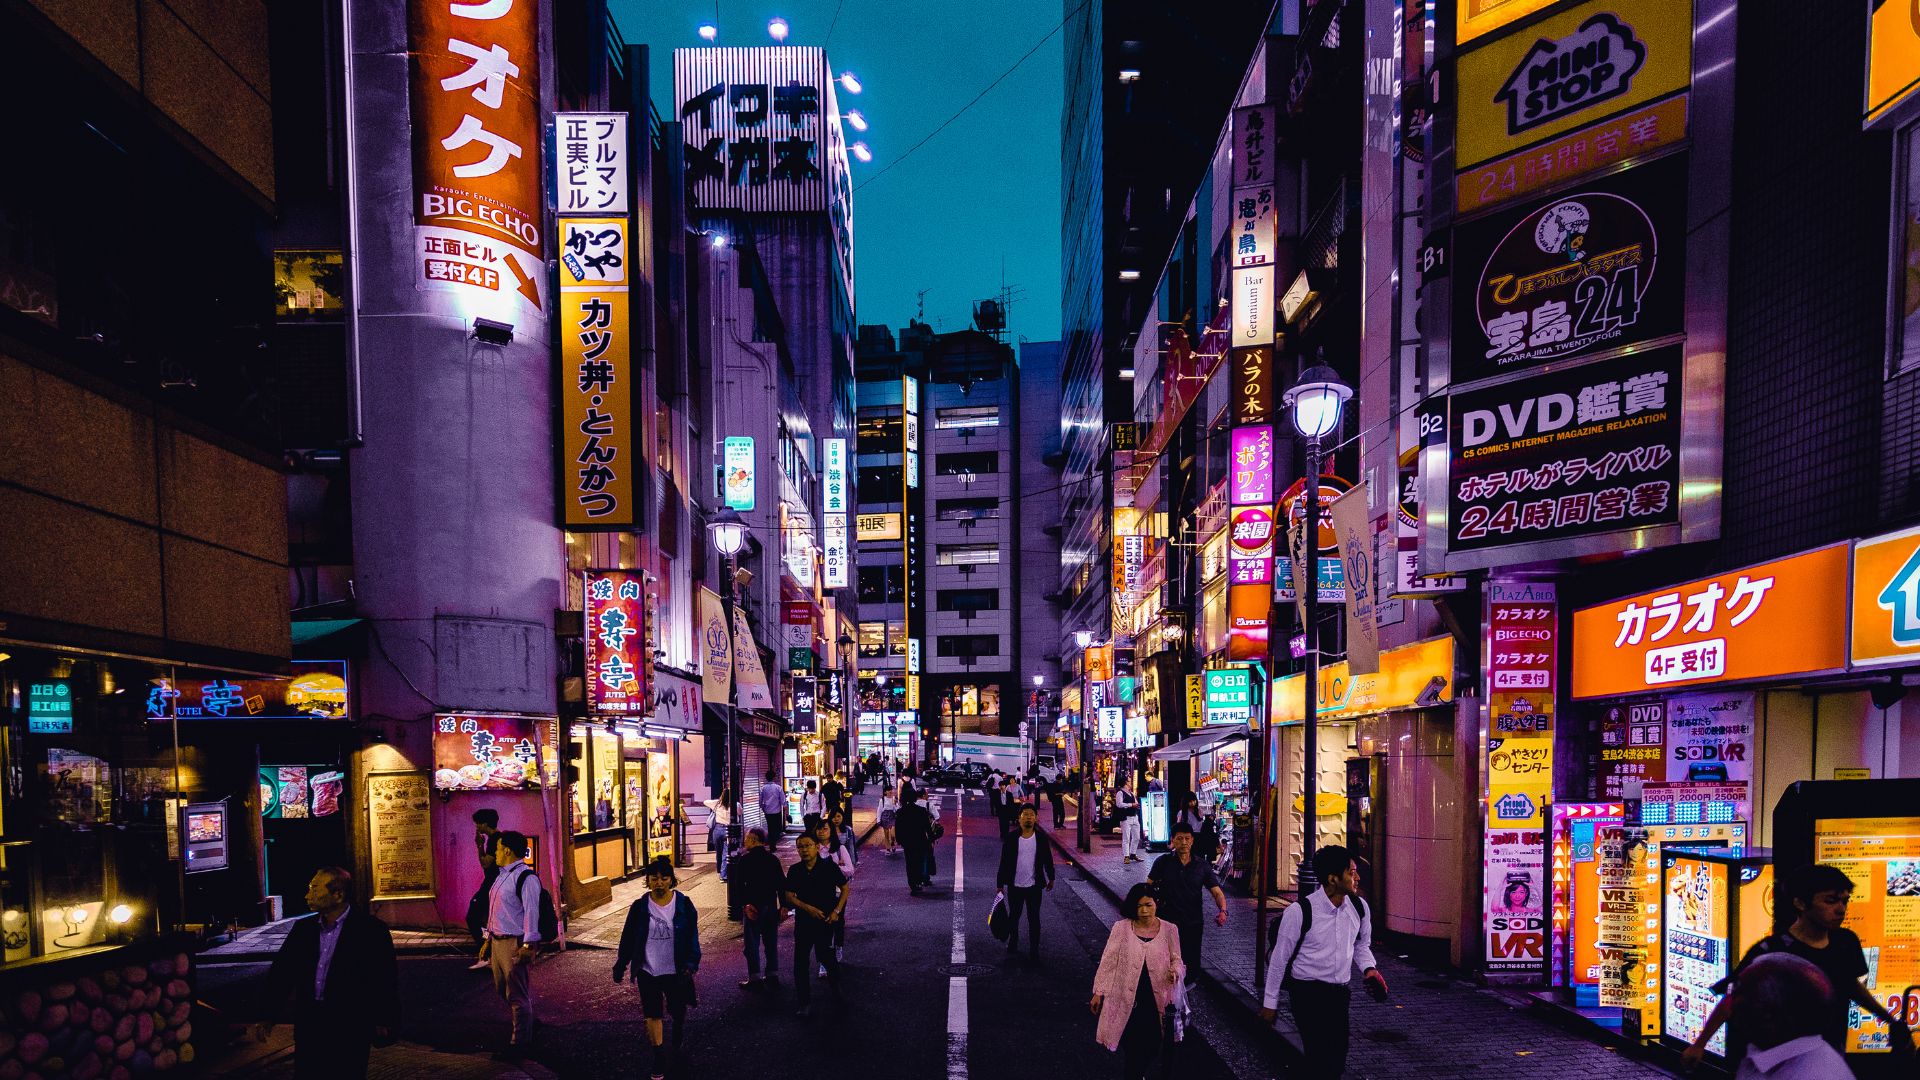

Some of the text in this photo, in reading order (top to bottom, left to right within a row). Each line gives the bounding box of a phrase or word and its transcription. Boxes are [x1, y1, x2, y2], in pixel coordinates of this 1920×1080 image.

[1528, 35, 1611, 91] MINI
[440, 0, 523, 178] オケ
[1523, 62, 1616, 118] STOP
[566, 119, 590, 210] 正実ビル
[595, 118, 618, 210] ブルマン
[1479, 114, 1660, 202] 24時間営業
[423, 193, 540, 247] BIG ECHO
[1558, 205, 1585, 218] room
[424, 236, 498, 263] 正面ビル
[564, 226, 622, 278] かつや
[1424, 246, 1444, 273] B1
[429, 261, 498, 287] 受付4F
[1245, 276, 1264, 286] Bar
[1497, 346, 1553, 365] TAKARAJIMA
[1242, 349, 1264, 415] バラの木
[578, 298, 617, 518] カツ丼・とんかつ
[1462, 371, 1669, 447] DVD鑑賞
[1420, 413, 1443, 438] B2
[1463, 412, 1667, 459] CS COMICS INTERNET MAGAZINE RELAXATION
[1256, 430, 1270, 472] スナック
[1236, 444, 1255, 490] ポワ
[1457, 444, 1672, 502] ホテルがライバル
[1456, 480, 1671, 540] 24時間営業
[859, 516, 885, 531] 和民
[1232, 521, 1273, 541] 楽園
[828, 546, 838, 577] 金の目
[1237, 569, 1265, 581] 右折
[1495, 608, 1551, 621] カラオケ
[1613, 575, 1775, 648] カラオケ
[1495, 630, 1552, 641] BIG ECHO
[1495, 652, 1550, 665] カラオケ
[1650, 645, 1718, 676] 4F 受付
[586, 638, 597, 715] RESTAURANT
[1225, 675, 1247, 687] 日立
[1498, 673, 1546, 685] 4F 受付
[604, 691, 626, 699] JUTEI
[630, 702, 641, 711] B1
[1210, 711, 1247, 721] 吉沢利工
[1631, 706, 1662, 723] DVD
[1490, 739, 1502, 749] 2F
[1630, 726, 1661, 744] 鑑賞
[1511, 748, 1550, 761] やきとり
[1602, 748, 1661, 762] 宝島24渋谷本店
[1511, 762, 1551, 774] センター
[1503, 801, 1526, 809] MINI
[1740, 868, 1758, 880] 2F
[1602, 889, 1626, 902] VR
[1491, 917, 1544, 931] SOD
[1490, 932, 1544, 959] VR
